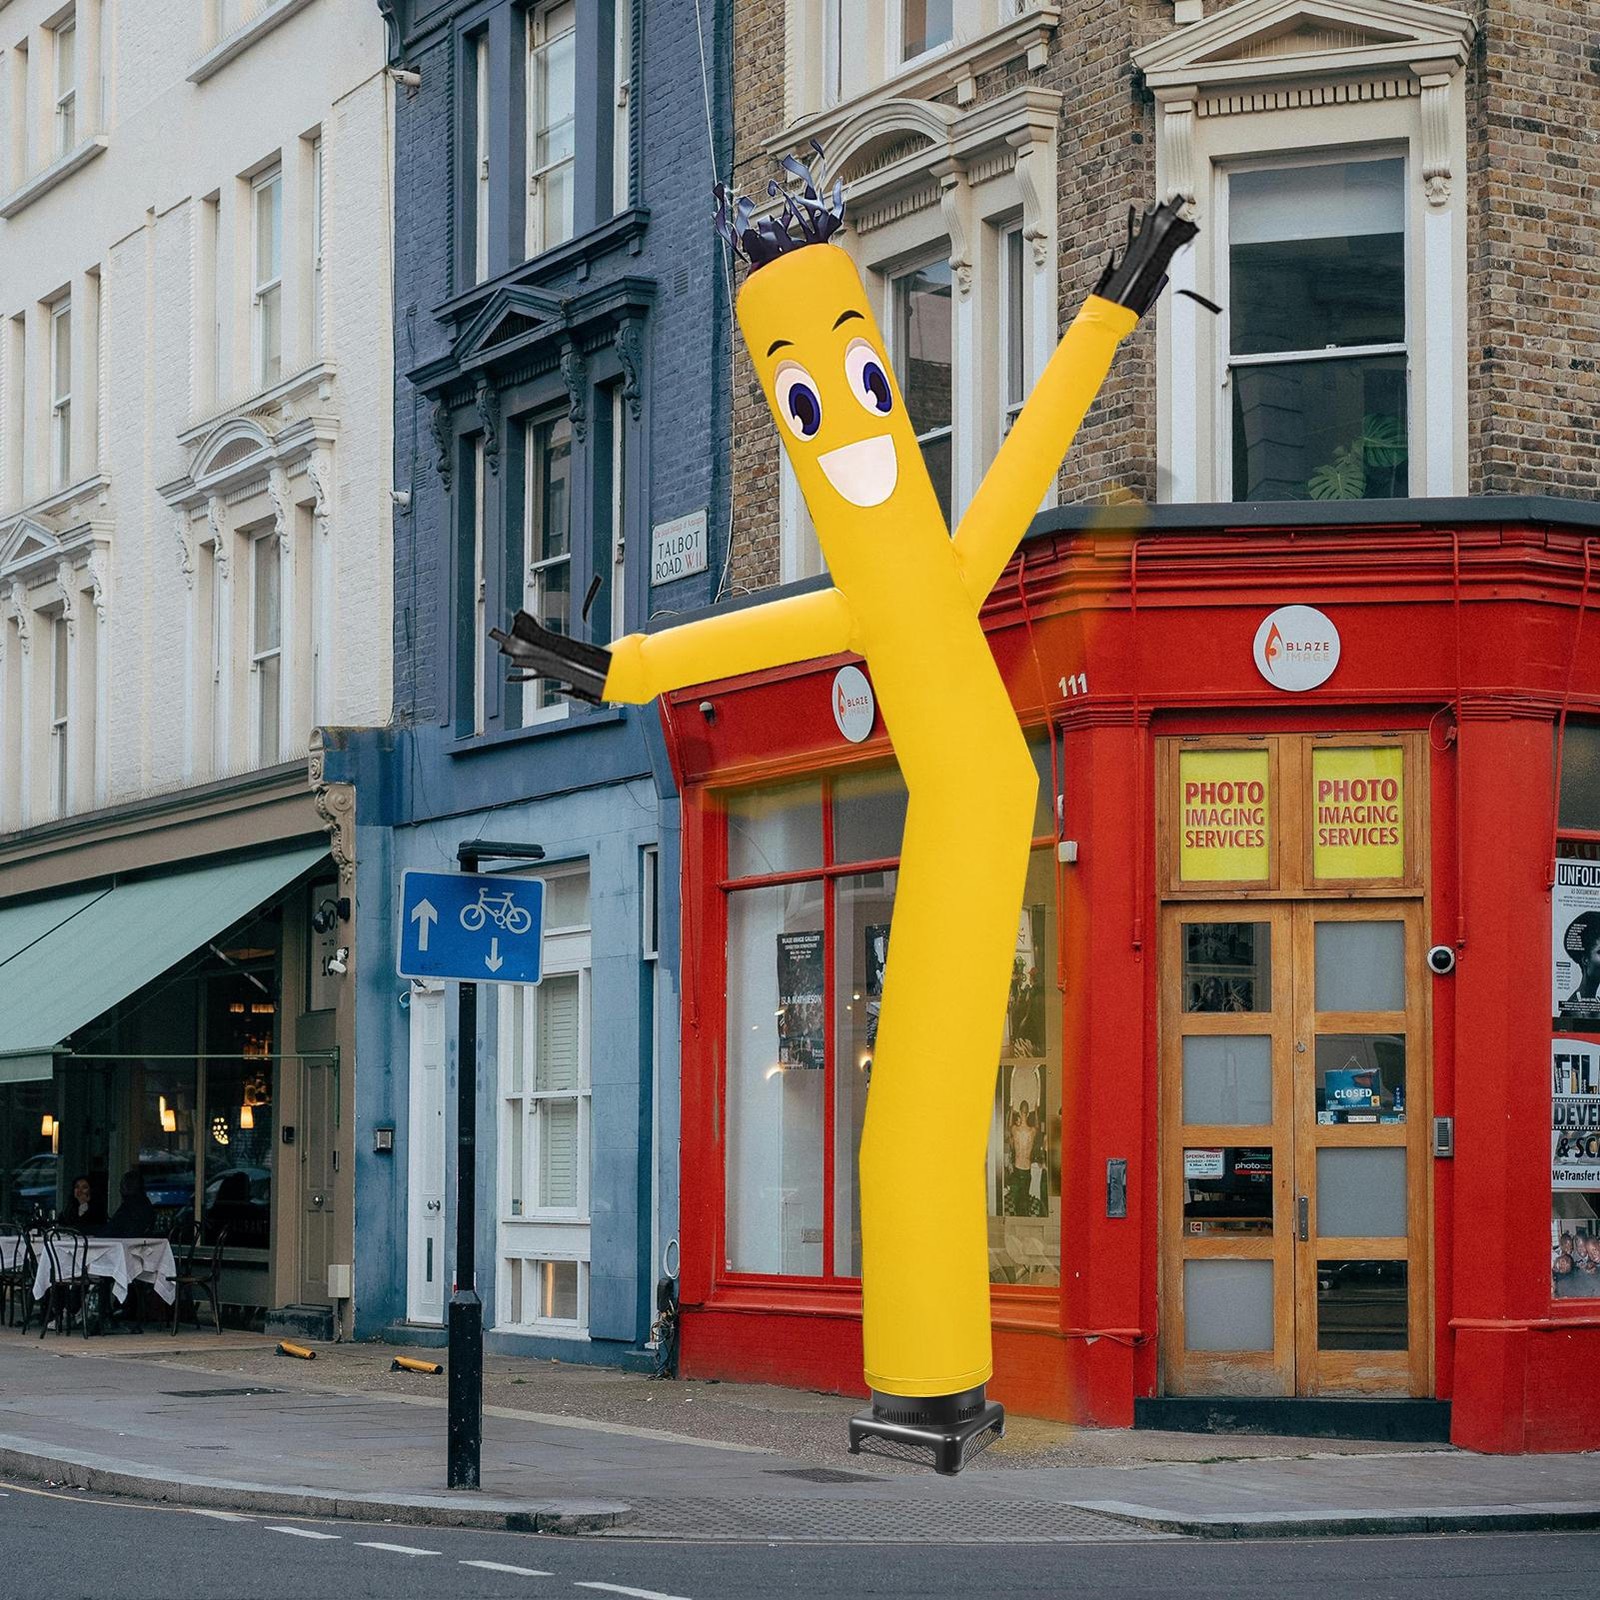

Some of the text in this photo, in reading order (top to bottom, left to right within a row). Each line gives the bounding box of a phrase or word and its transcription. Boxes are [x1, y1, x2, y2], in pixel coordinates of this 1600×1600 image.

[658, 530, 700, 560] TALBOT
[1286, 642, 1330, 651] BLAZE
[1286, 652, 1330, 662] IMAGE
[1058, 673, 1088, 698] 111
[846, 696, 869, 708] BLAZE
[1184, 781, 1265, 805] PHOTO
[1318, 778, 1399, 802] PHOTO
[1185, 808, 1265, 826] IMAGING
[1318, 805, 1399, 824] IMAGING
[1185, 829, 1265, 848] SERVICES
[1318, 827, 1399, 846] SERVICES
[1553, 1054, 1600, 1095] FIL
[1334, 1088, 1373, 1099] CLOSED
[1557, 1138, 1571, 1159] &
[1553, 1170, 1595, 1181] WeTransfer
